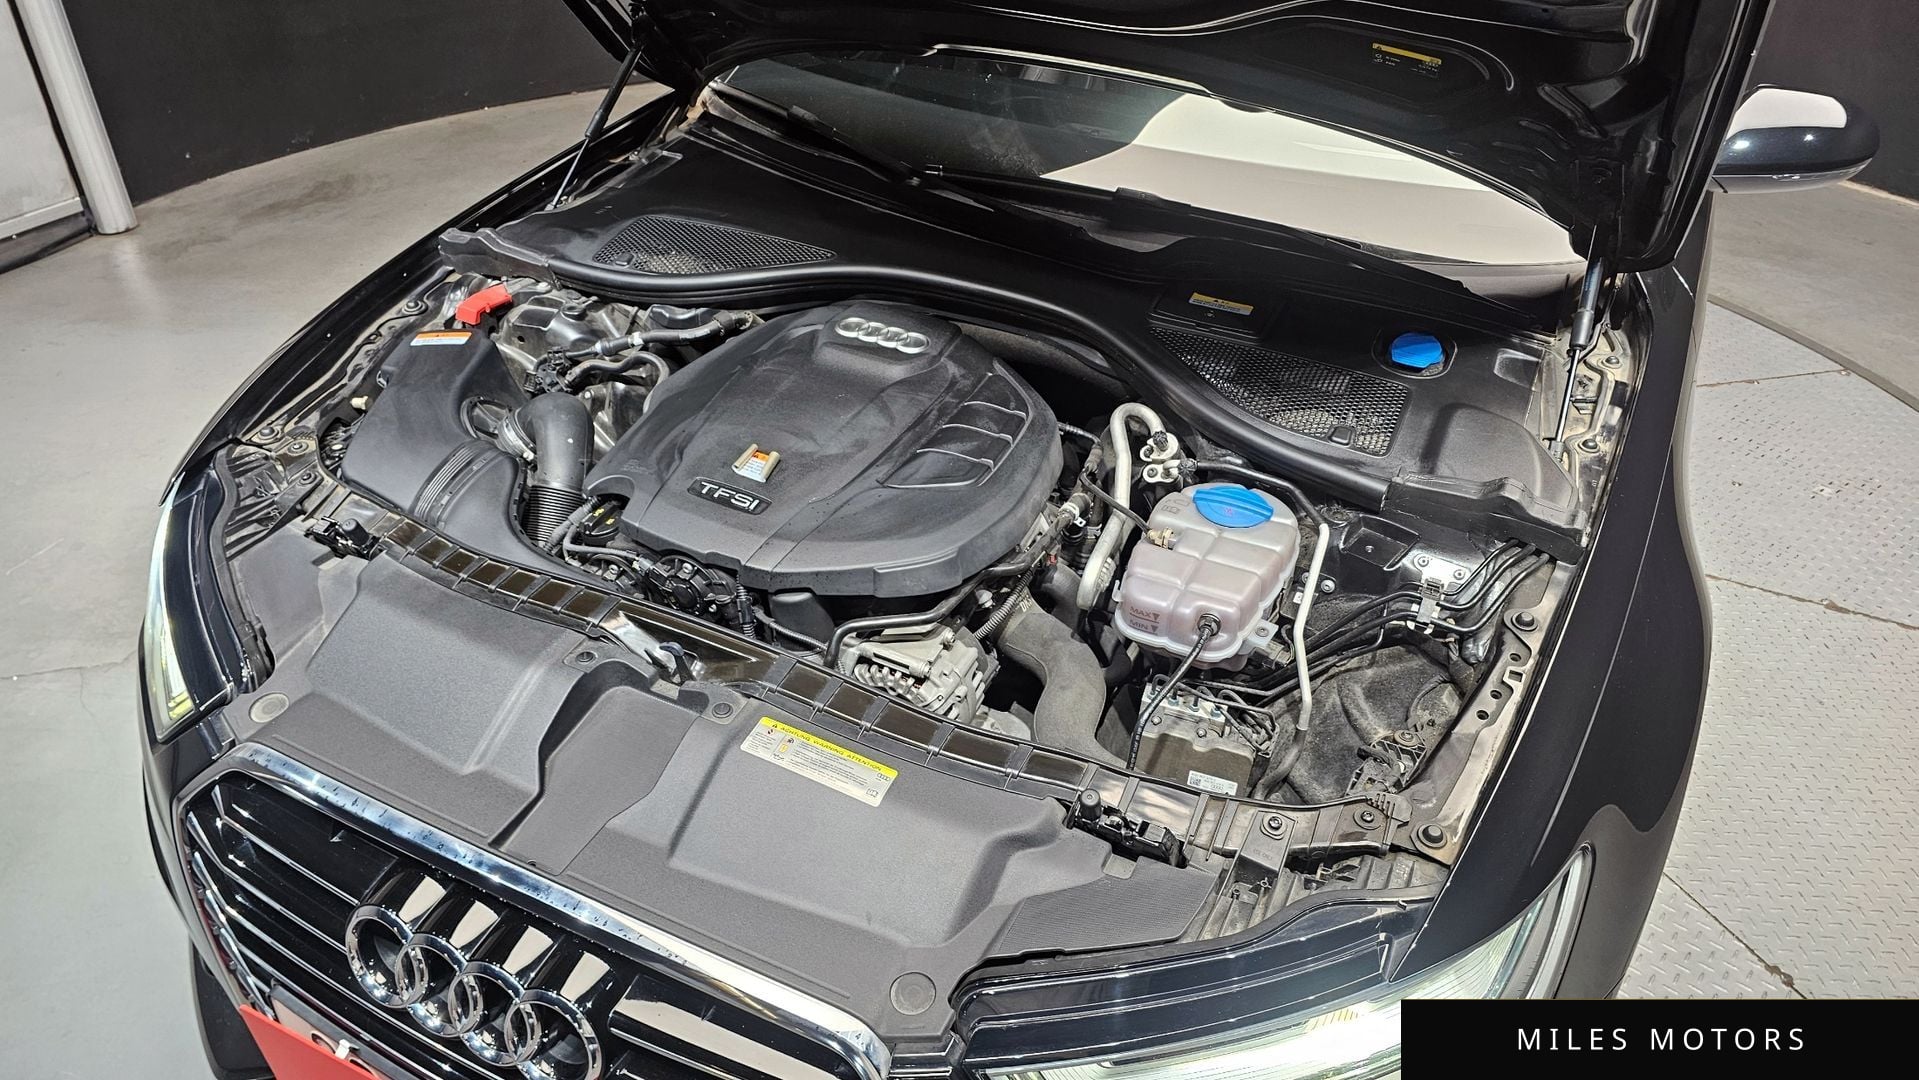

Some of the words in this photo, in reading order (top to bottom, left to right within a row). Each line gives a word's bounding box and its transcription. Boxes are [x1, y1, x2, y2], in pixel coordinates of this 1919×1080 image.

[701, 481, 760, 511] TFSI
[1130, 606, 1152, 618] MAX
[1130, 619, 1149, 630] MIN
[780, 726, 811, 742] ACHTUNG
[813, 740, 845, 755] WARNING
[846, 753, 882, 771] ATTENTION
